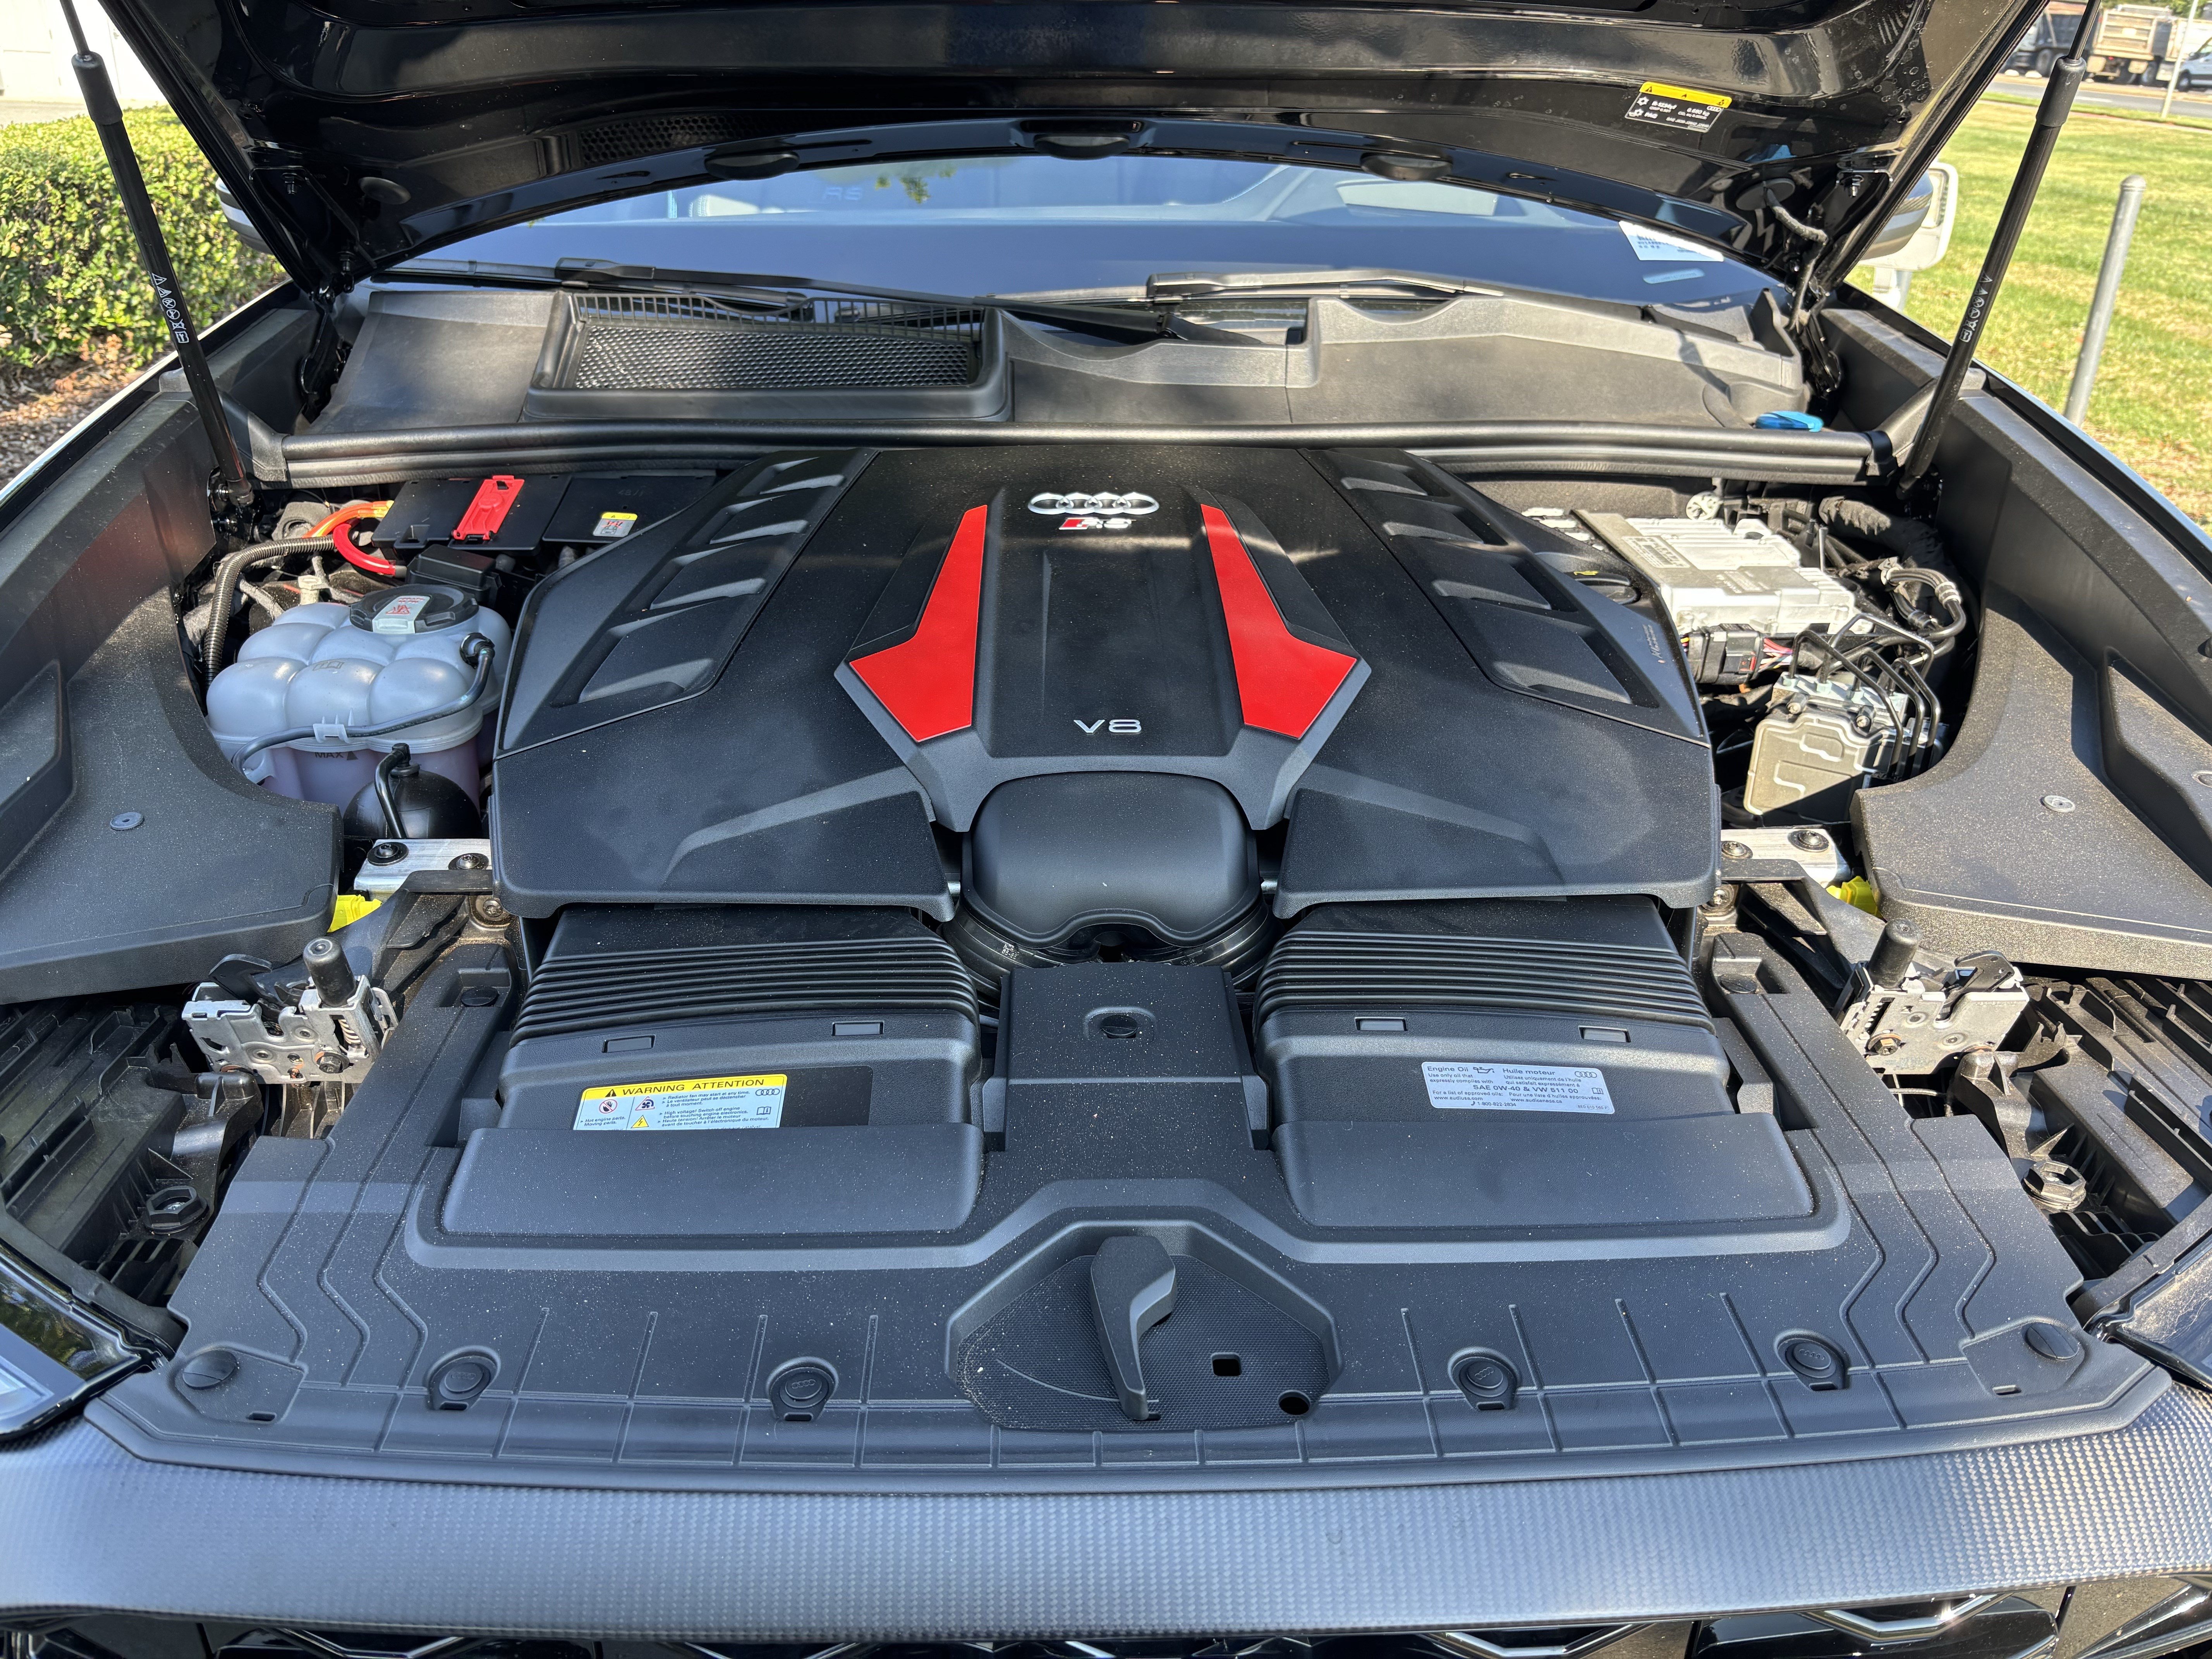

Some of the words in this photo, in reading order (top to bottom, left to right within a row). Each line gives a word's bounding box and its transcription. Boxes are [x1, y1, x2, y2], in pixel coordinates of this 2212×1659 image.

[1073, 719, 1142, 733] V8
[623, 1084, 685, 1095] WARNING
[692, 1079, 764, 1091] ATTENTION
